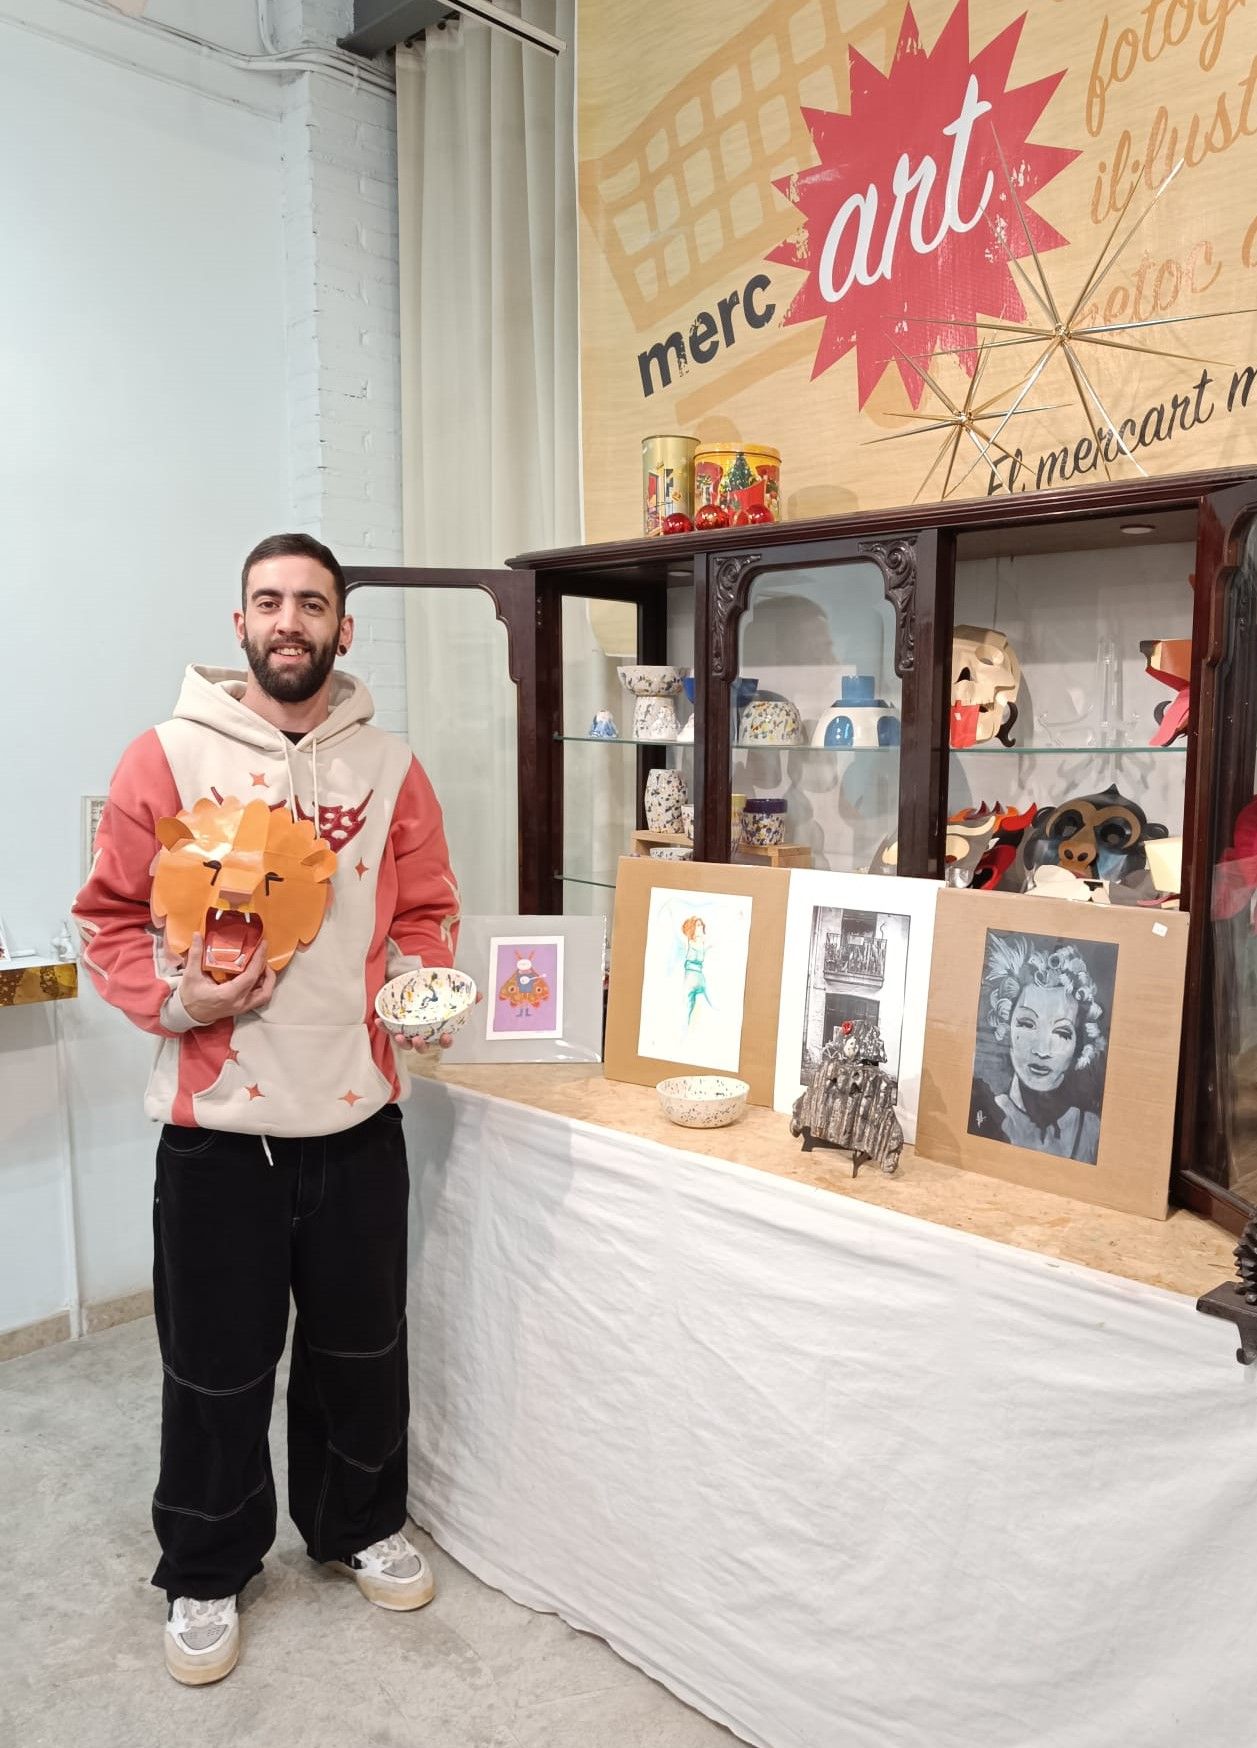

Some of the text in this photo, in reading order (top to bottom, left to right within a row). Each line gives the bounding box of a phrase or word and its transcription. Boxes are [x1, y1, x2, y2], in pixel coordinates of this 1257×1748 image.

[1085, 0, 1246, 138] fotog
[638, 74, 995, 398] merc art
[1036, 368, 1216, 489] mercart
